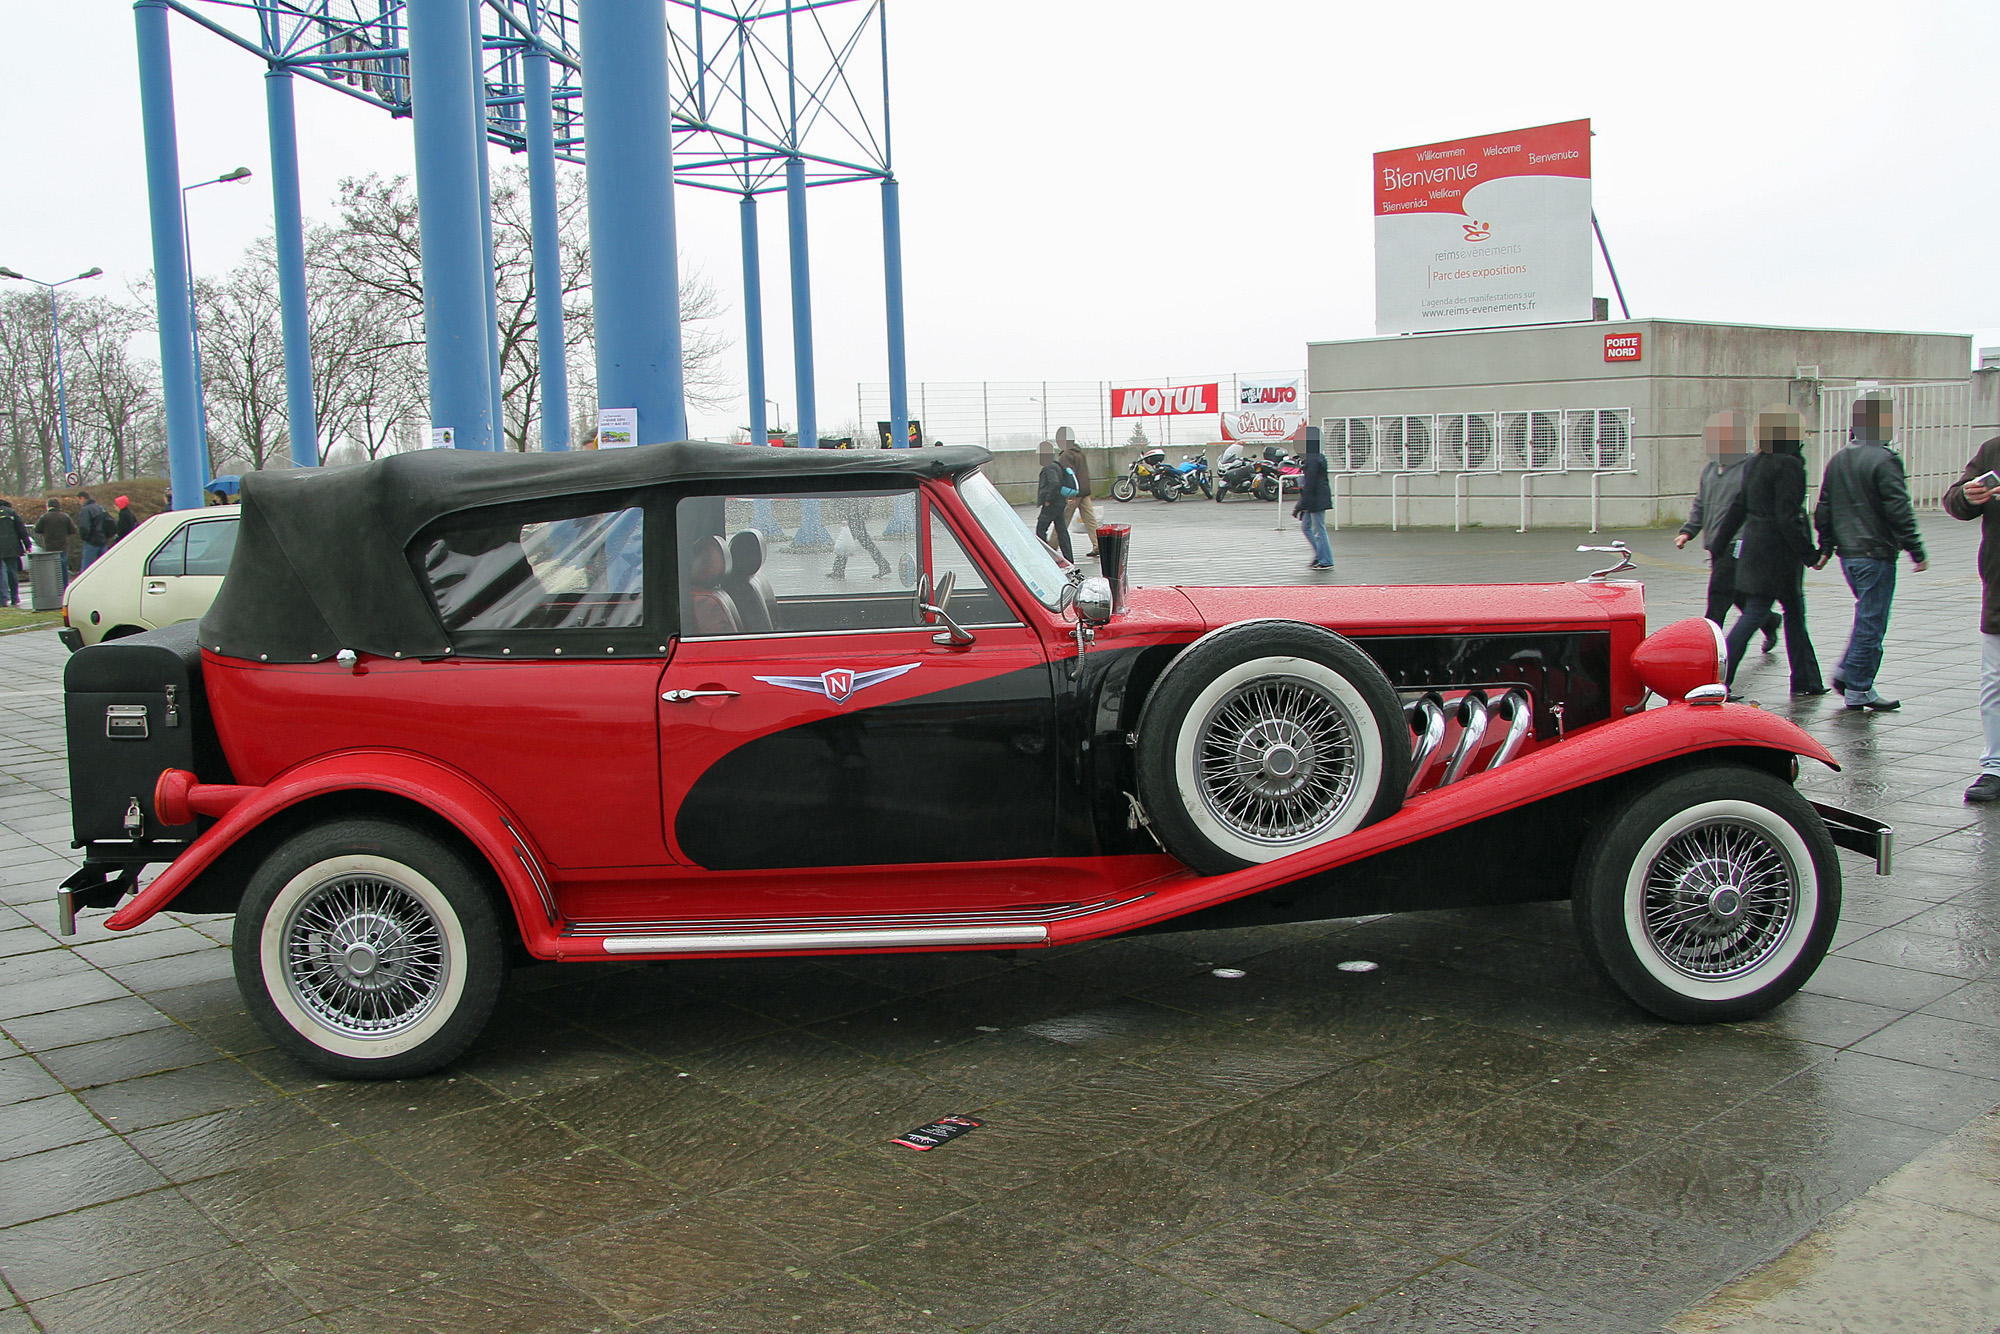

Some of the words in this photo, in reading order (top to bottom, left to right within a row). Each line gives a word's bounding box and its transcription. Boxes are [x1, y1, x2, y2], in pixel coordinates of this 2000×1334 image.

[1416, 147, 1466, 162] Willkommen
[1482, 144, 1522, 157] Welcome
[1528, 150, 1579, 165] Benvenuto
[1383, 162, 1479, 191] Bienvenue
[1428, 188, 1461, 200] Welkom
[1382, 198, 1428, 213] Bienvenida
[1433, 270, 1452, 282] Parc
[1454, 268, 1471, 280] des
[1472, 263, 1527, 279] expositions
[1421, 297, 1453, 308] L'agenda
[1455, 295, 1467, 304] des
[1468, 291, 1522, 304] manifestations
[1523, 291, 1536, 299] sur
[1421, 299, 1537, 318] www.reims-evenements.fr
[1606, 337, 1638, 348] PORTE
[1608, 347, 1637, 358] NORD
[1121, 385, 1209, 415] MOTUL
[1237, 411, 1286, 434] d'Auto
[829, 676, 848, 694] N
[1348, 701, 1367, 727] ATLAS
